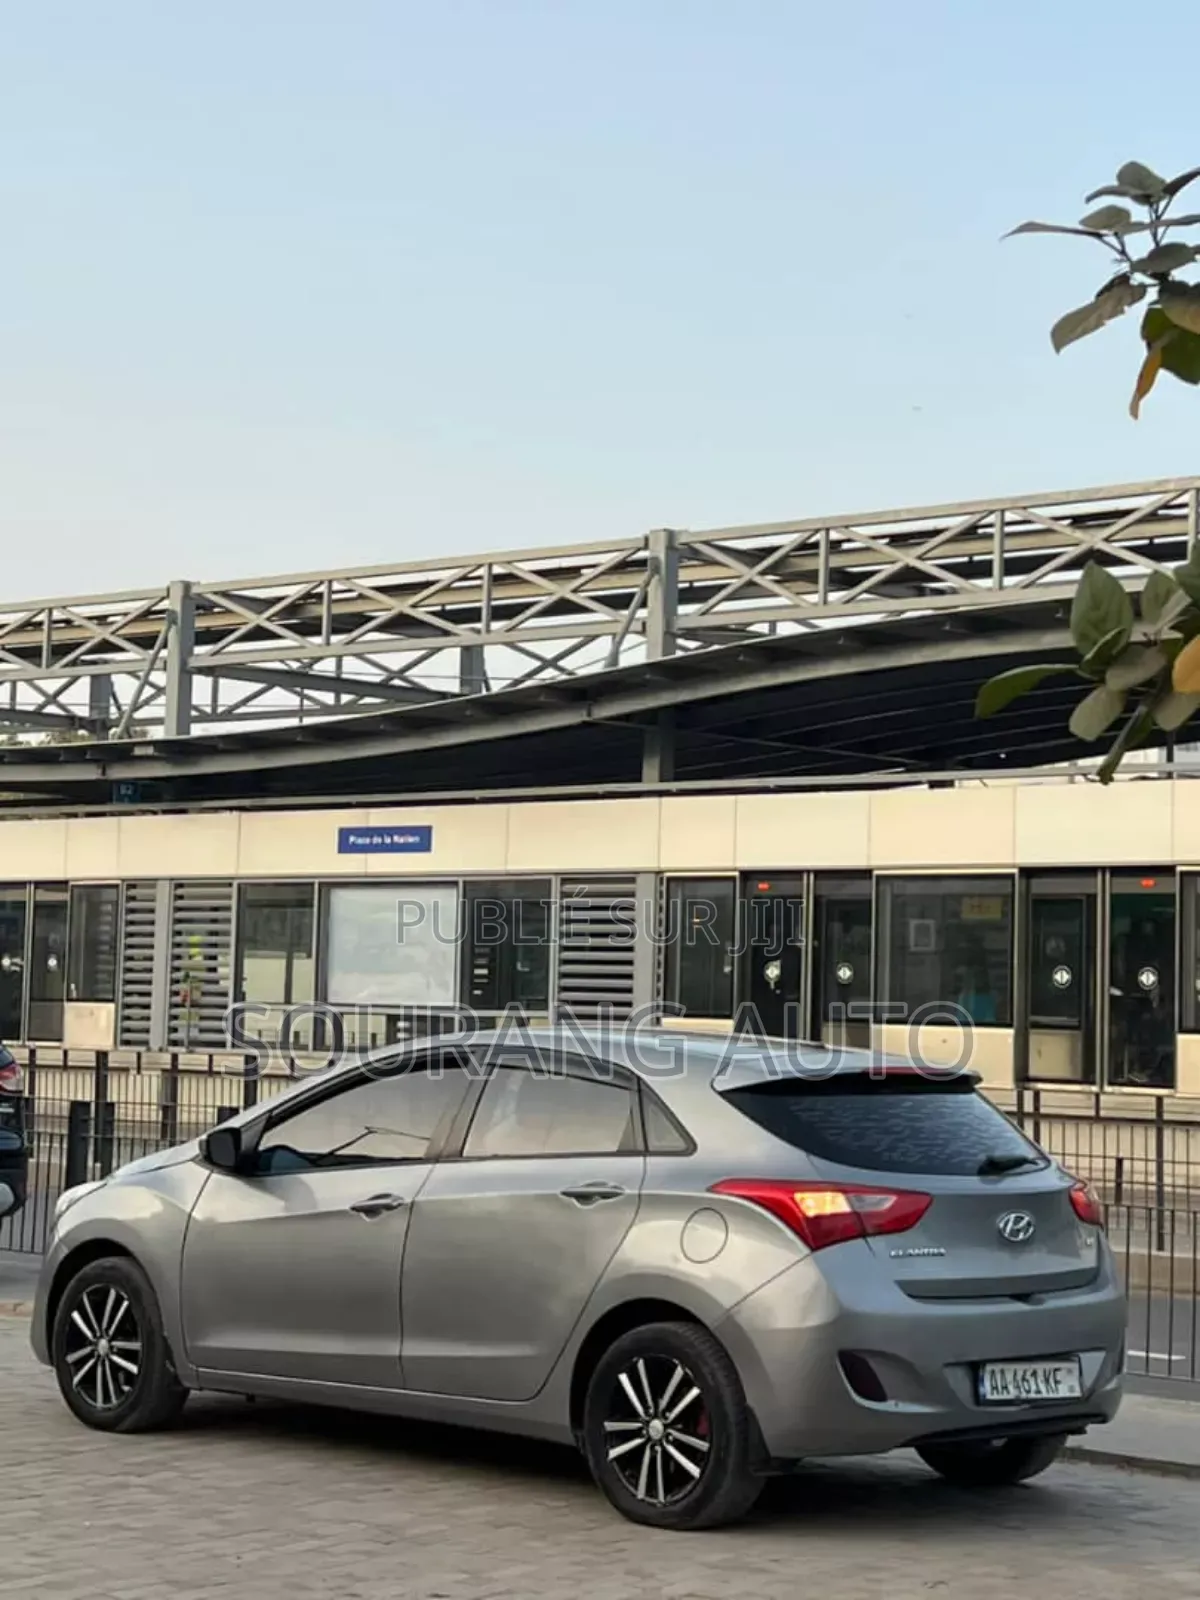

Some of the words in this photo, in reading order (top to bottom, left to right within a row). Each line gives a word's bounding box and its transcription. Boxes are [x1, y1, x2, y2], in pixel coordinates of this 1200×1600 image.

[348, 834, 370, 845] Place
[372, 834, 382, 844] de
[384, 834, 391, 844] la
